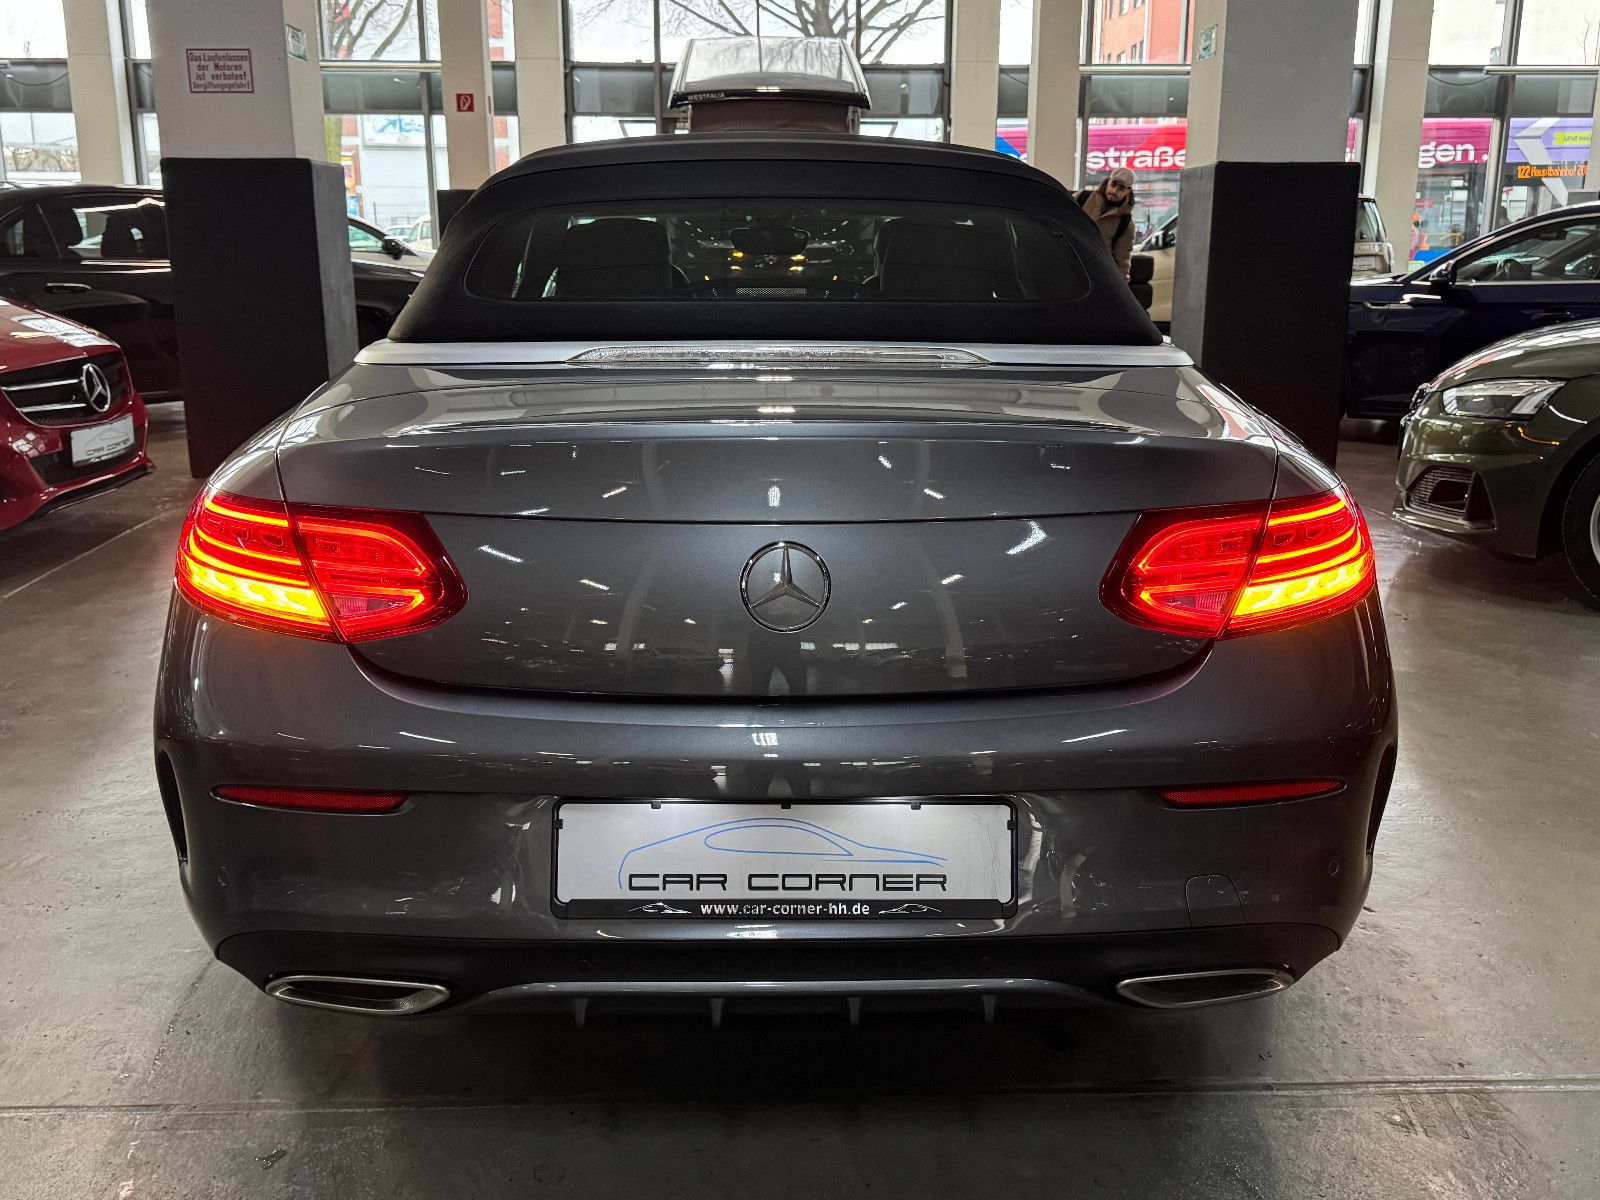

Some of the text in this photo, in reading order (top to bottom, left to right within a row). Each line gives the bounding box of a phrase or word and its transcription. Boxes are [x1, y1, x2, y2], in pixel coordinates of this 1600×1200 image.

[197, 62, 209, 71] der
[628, 873, 947, 891] CAR CORNER
[700, 902, 870, 915] www.car-corner-hh.de
